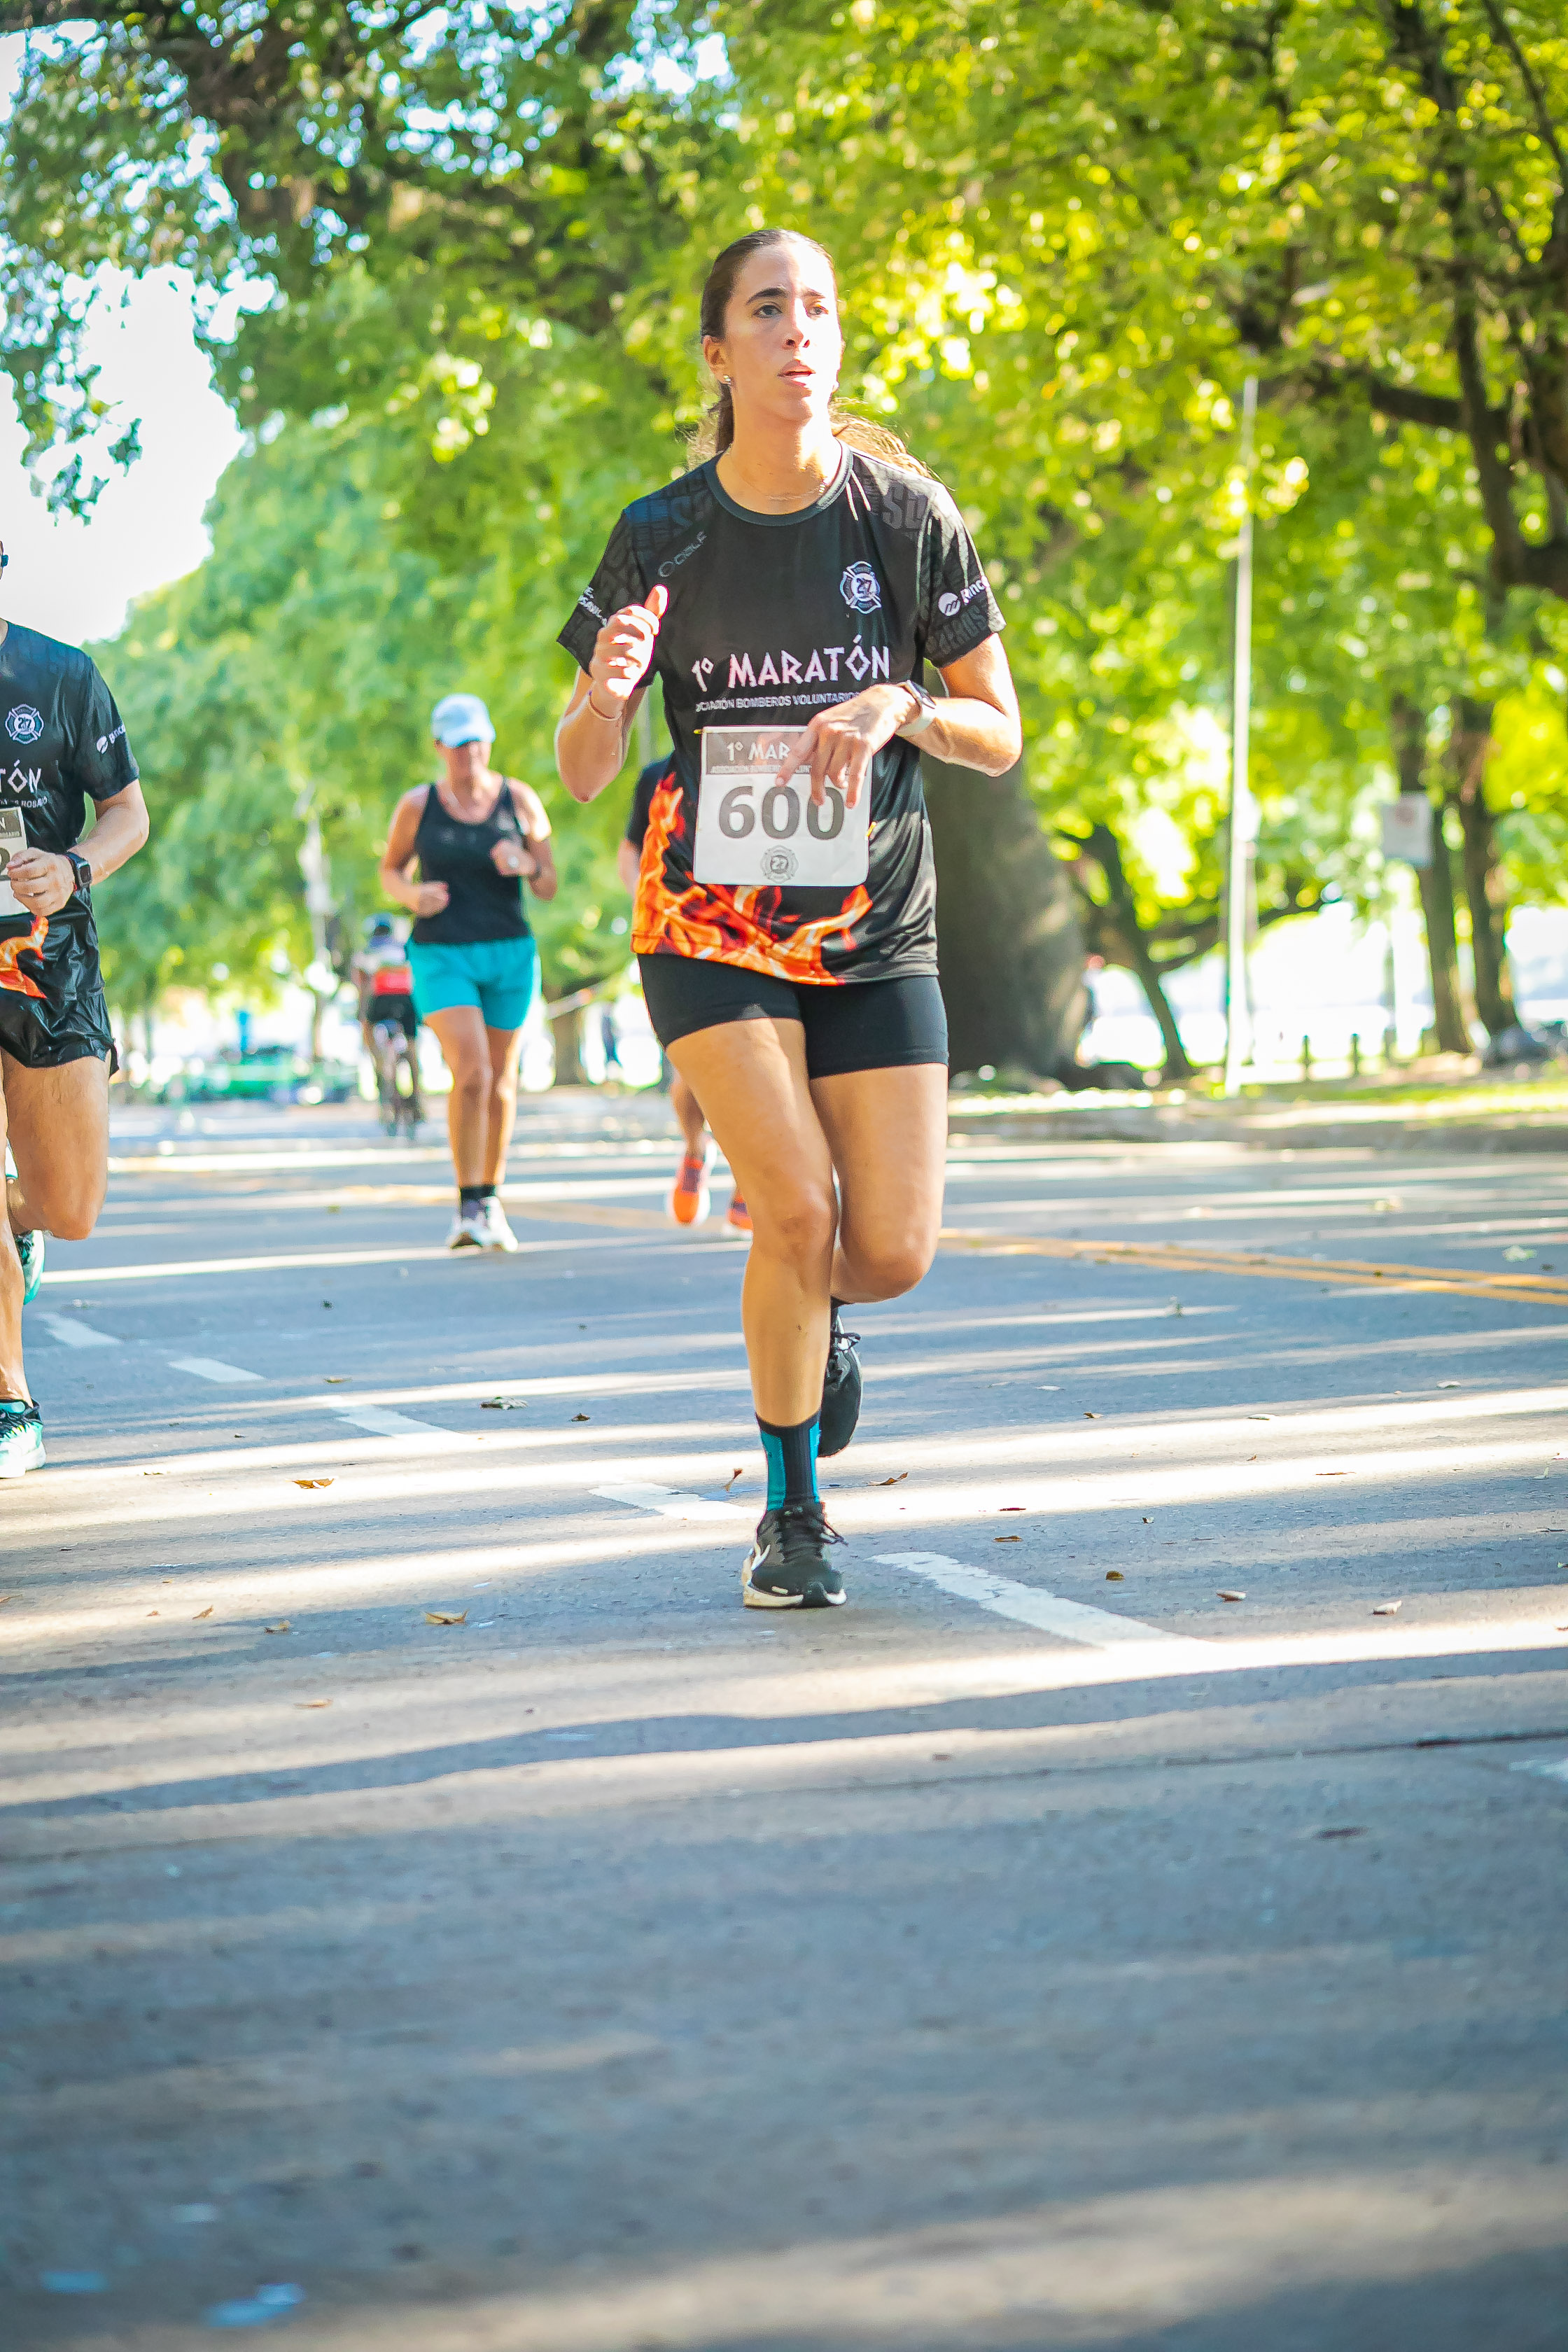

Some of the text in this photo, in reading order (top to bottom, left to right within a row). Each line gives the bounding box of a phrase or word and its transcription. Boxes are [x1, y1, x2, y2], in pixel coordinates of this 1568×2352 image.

[855, 578, 873, 594] 27
[728, 634, 890, 689] MARATÓN
[736, 694, 792, 708] BOMBEROS
[18, 716, 32, 729] 27
[719, 785, 844, 840] 600
